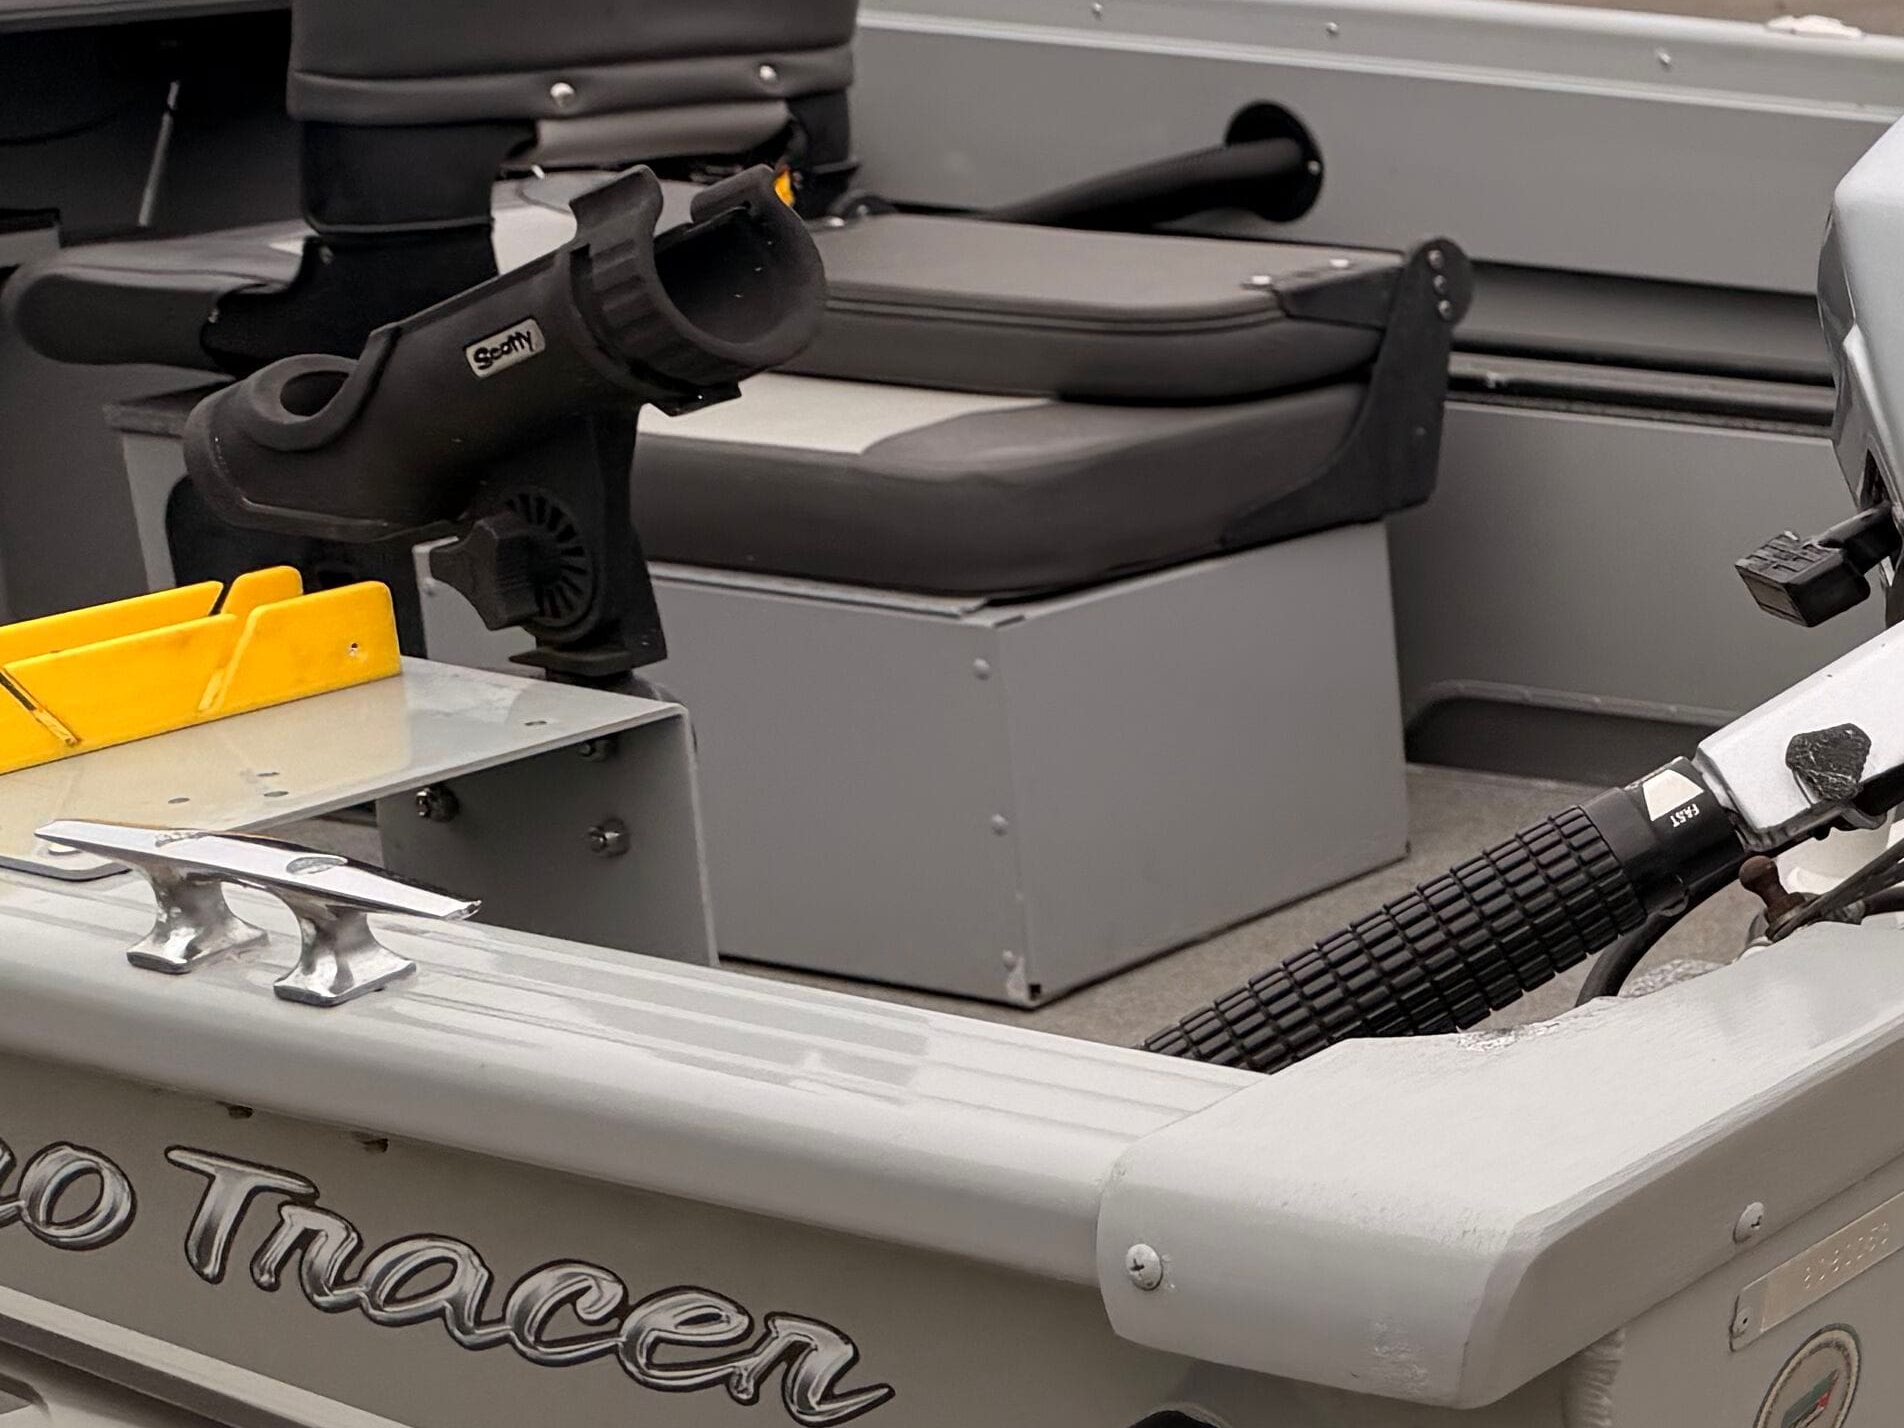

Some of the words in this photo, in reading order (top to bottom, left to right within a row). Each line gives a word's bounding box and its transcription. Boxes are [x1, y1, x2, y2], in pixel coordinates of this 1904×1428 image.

[474, 331, 534, 370] Scotty
[1670, 803, 1700, 828] FAST
[164, 1145, 895, 1428] Tracer
